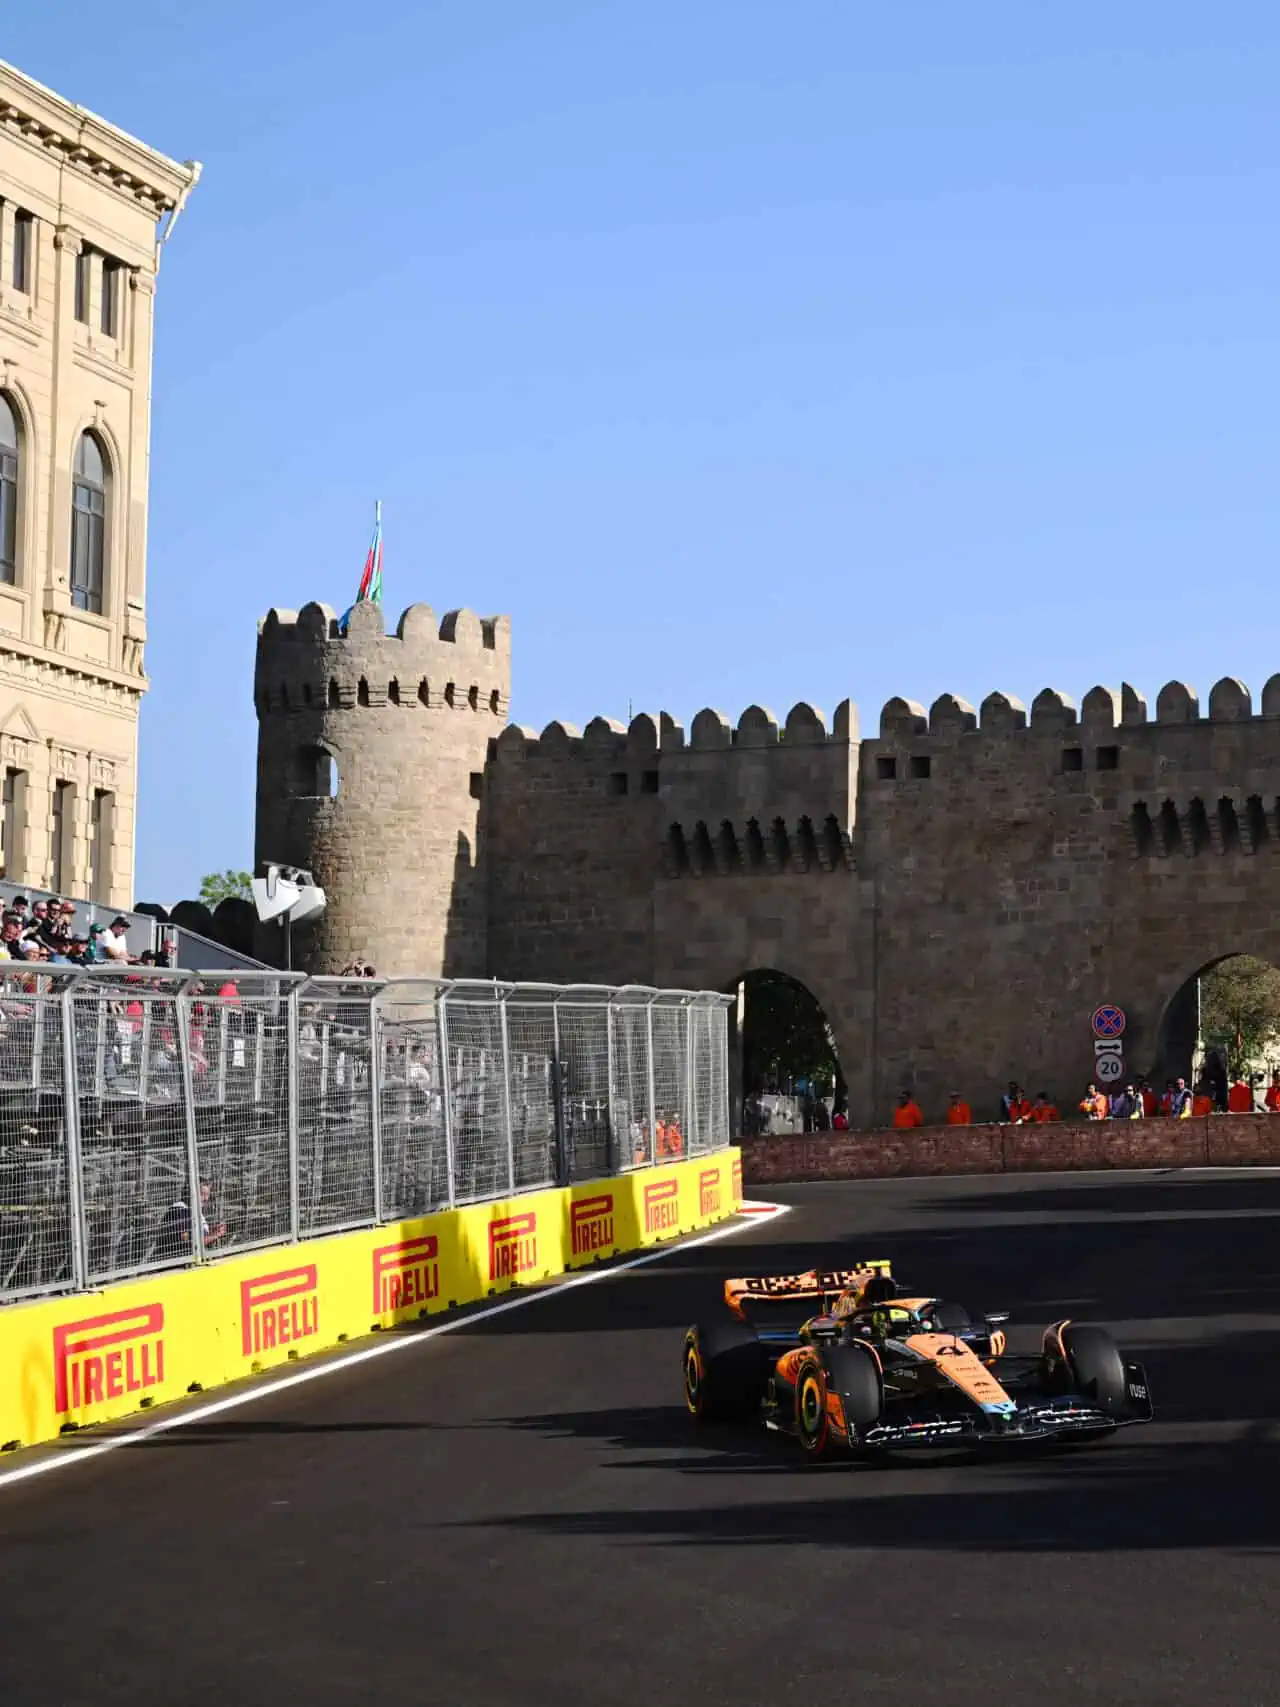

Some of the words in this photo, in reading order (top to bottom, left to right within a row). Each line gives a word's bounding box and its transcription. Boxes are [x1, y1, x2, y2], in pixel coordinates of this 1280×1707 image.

[1101, 1061, 1119, 1075] 20
[571, 1194, 614, 1255] PIRELLI
[644, 1177, 678, 1233] PIRELLI
[372, 1235, 439, 1315] PIRELLI
[488, 1212, 537, 1281] PIRELLI
[240, 1263, 319, 1357] PIRELLI
[53, 1302, 164, 1413] PIRELLI
